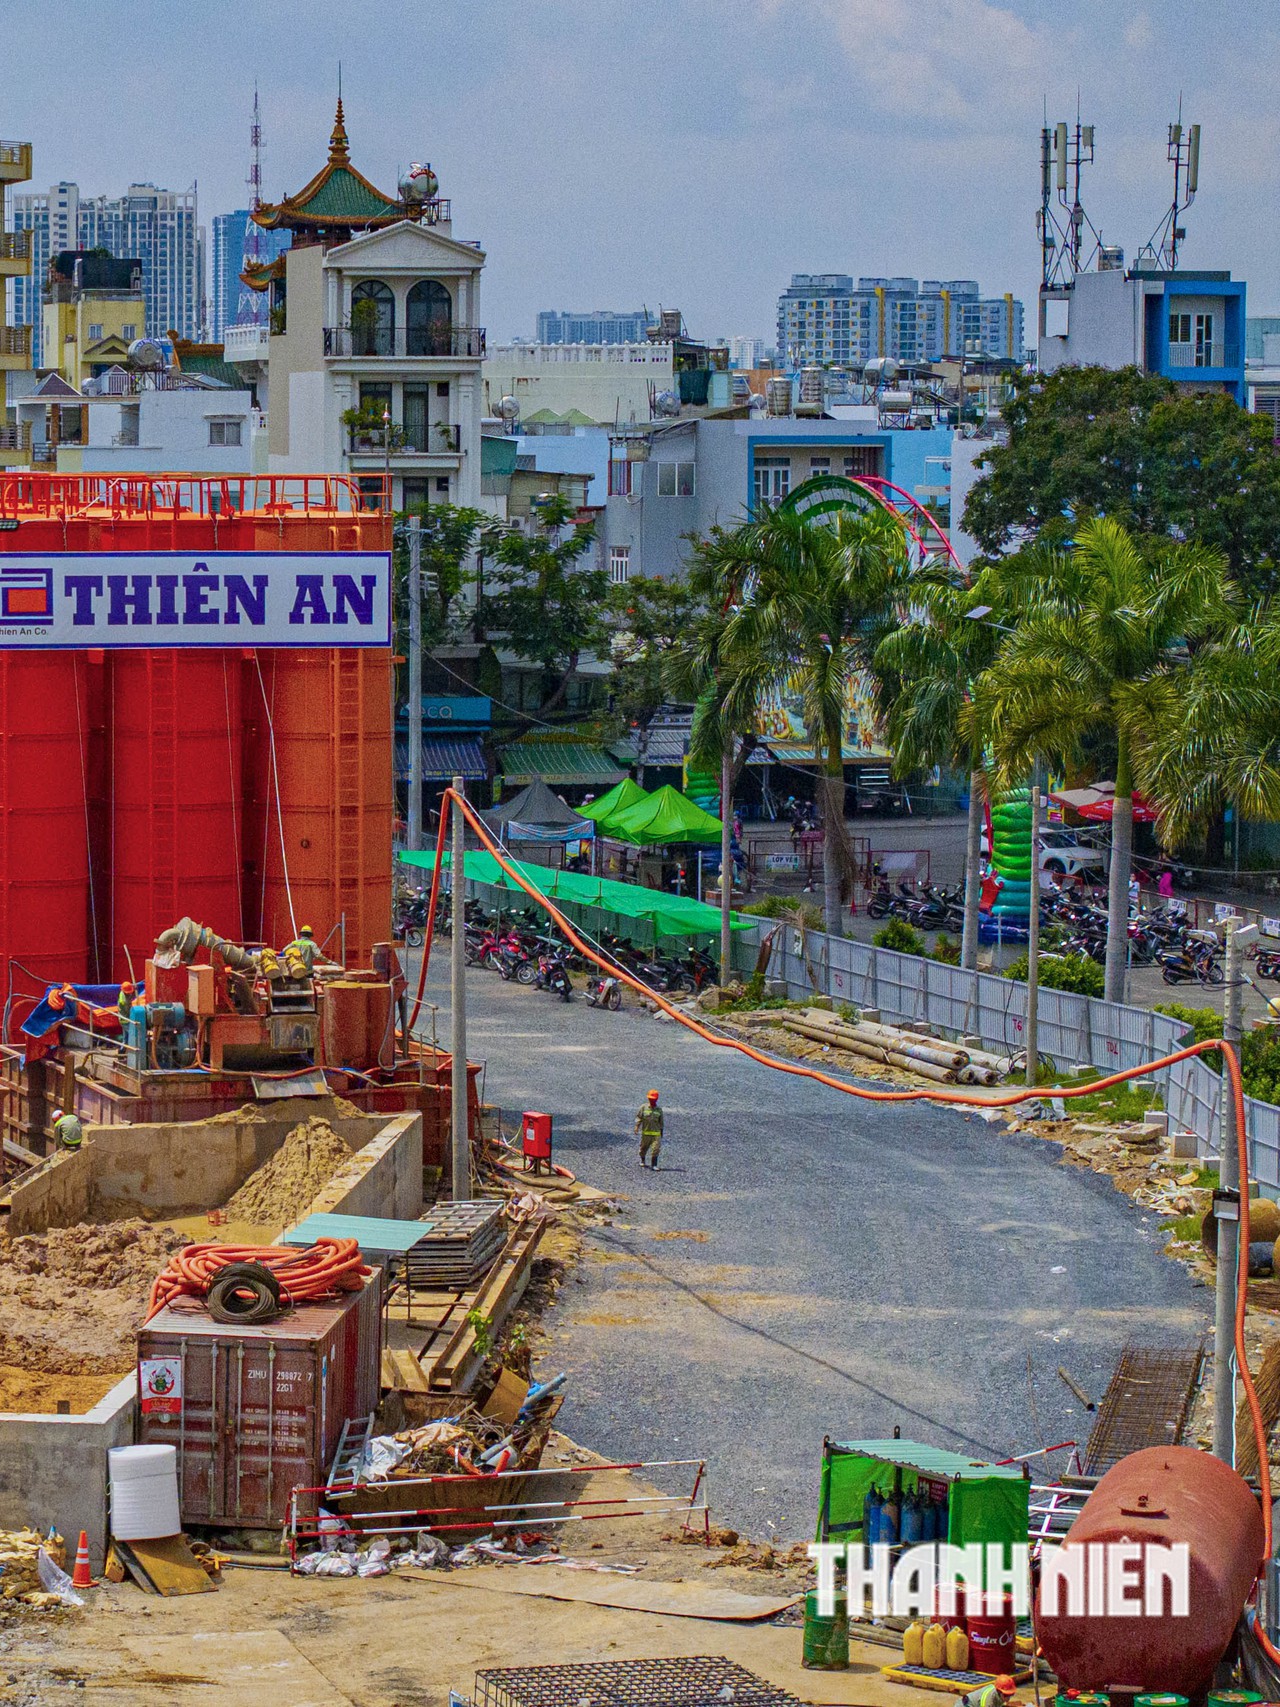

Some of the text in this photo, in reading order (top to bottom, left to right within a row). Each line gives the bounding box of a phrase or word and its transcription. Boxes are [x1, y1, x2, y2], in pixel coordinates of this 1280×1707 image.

[64, 562, 377, 626] THIÊN AN
[19, 627, 32, 636] An
[1012, 1018, 1023, 1032] T6
[247, 1369, 267, 1379] ZIMU
[276, 1383, 293, 1392] 22G1
